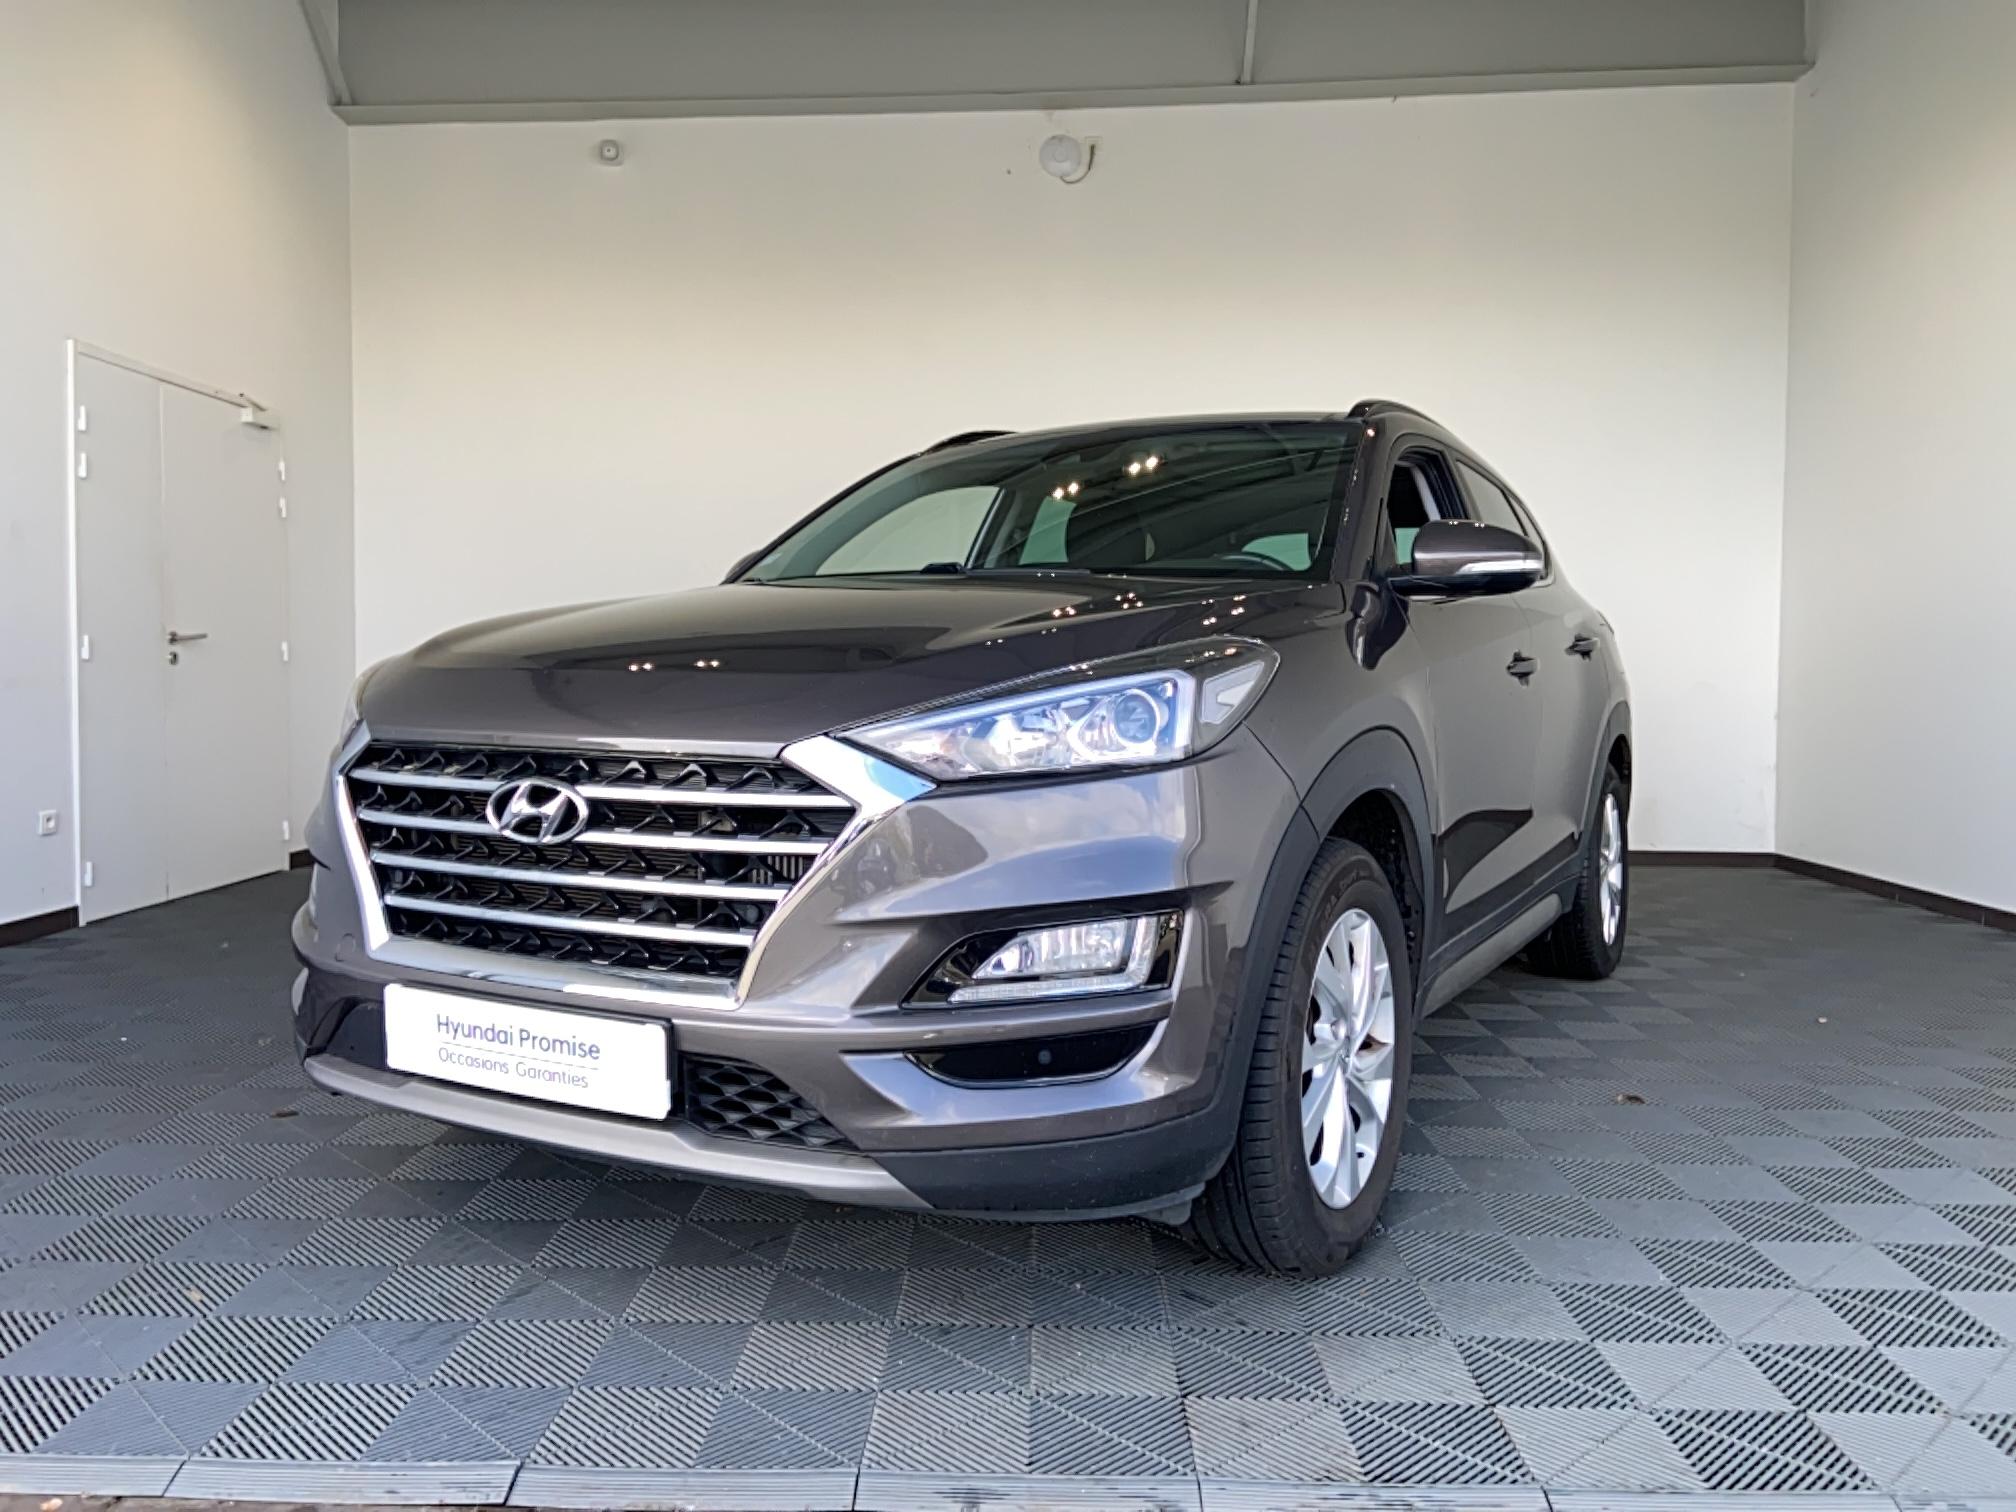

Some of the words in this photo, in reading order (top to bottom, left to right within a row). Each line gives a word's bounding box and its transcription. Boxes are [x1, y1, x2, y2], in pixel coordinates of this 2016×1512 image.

[436, 1014, 514, 1046] Hyundai
[519, 1028, 601, 1060] Promise
[438, 1047, 510, 1074] Occasions
[515, 1061, 589, 1088] Garanties
